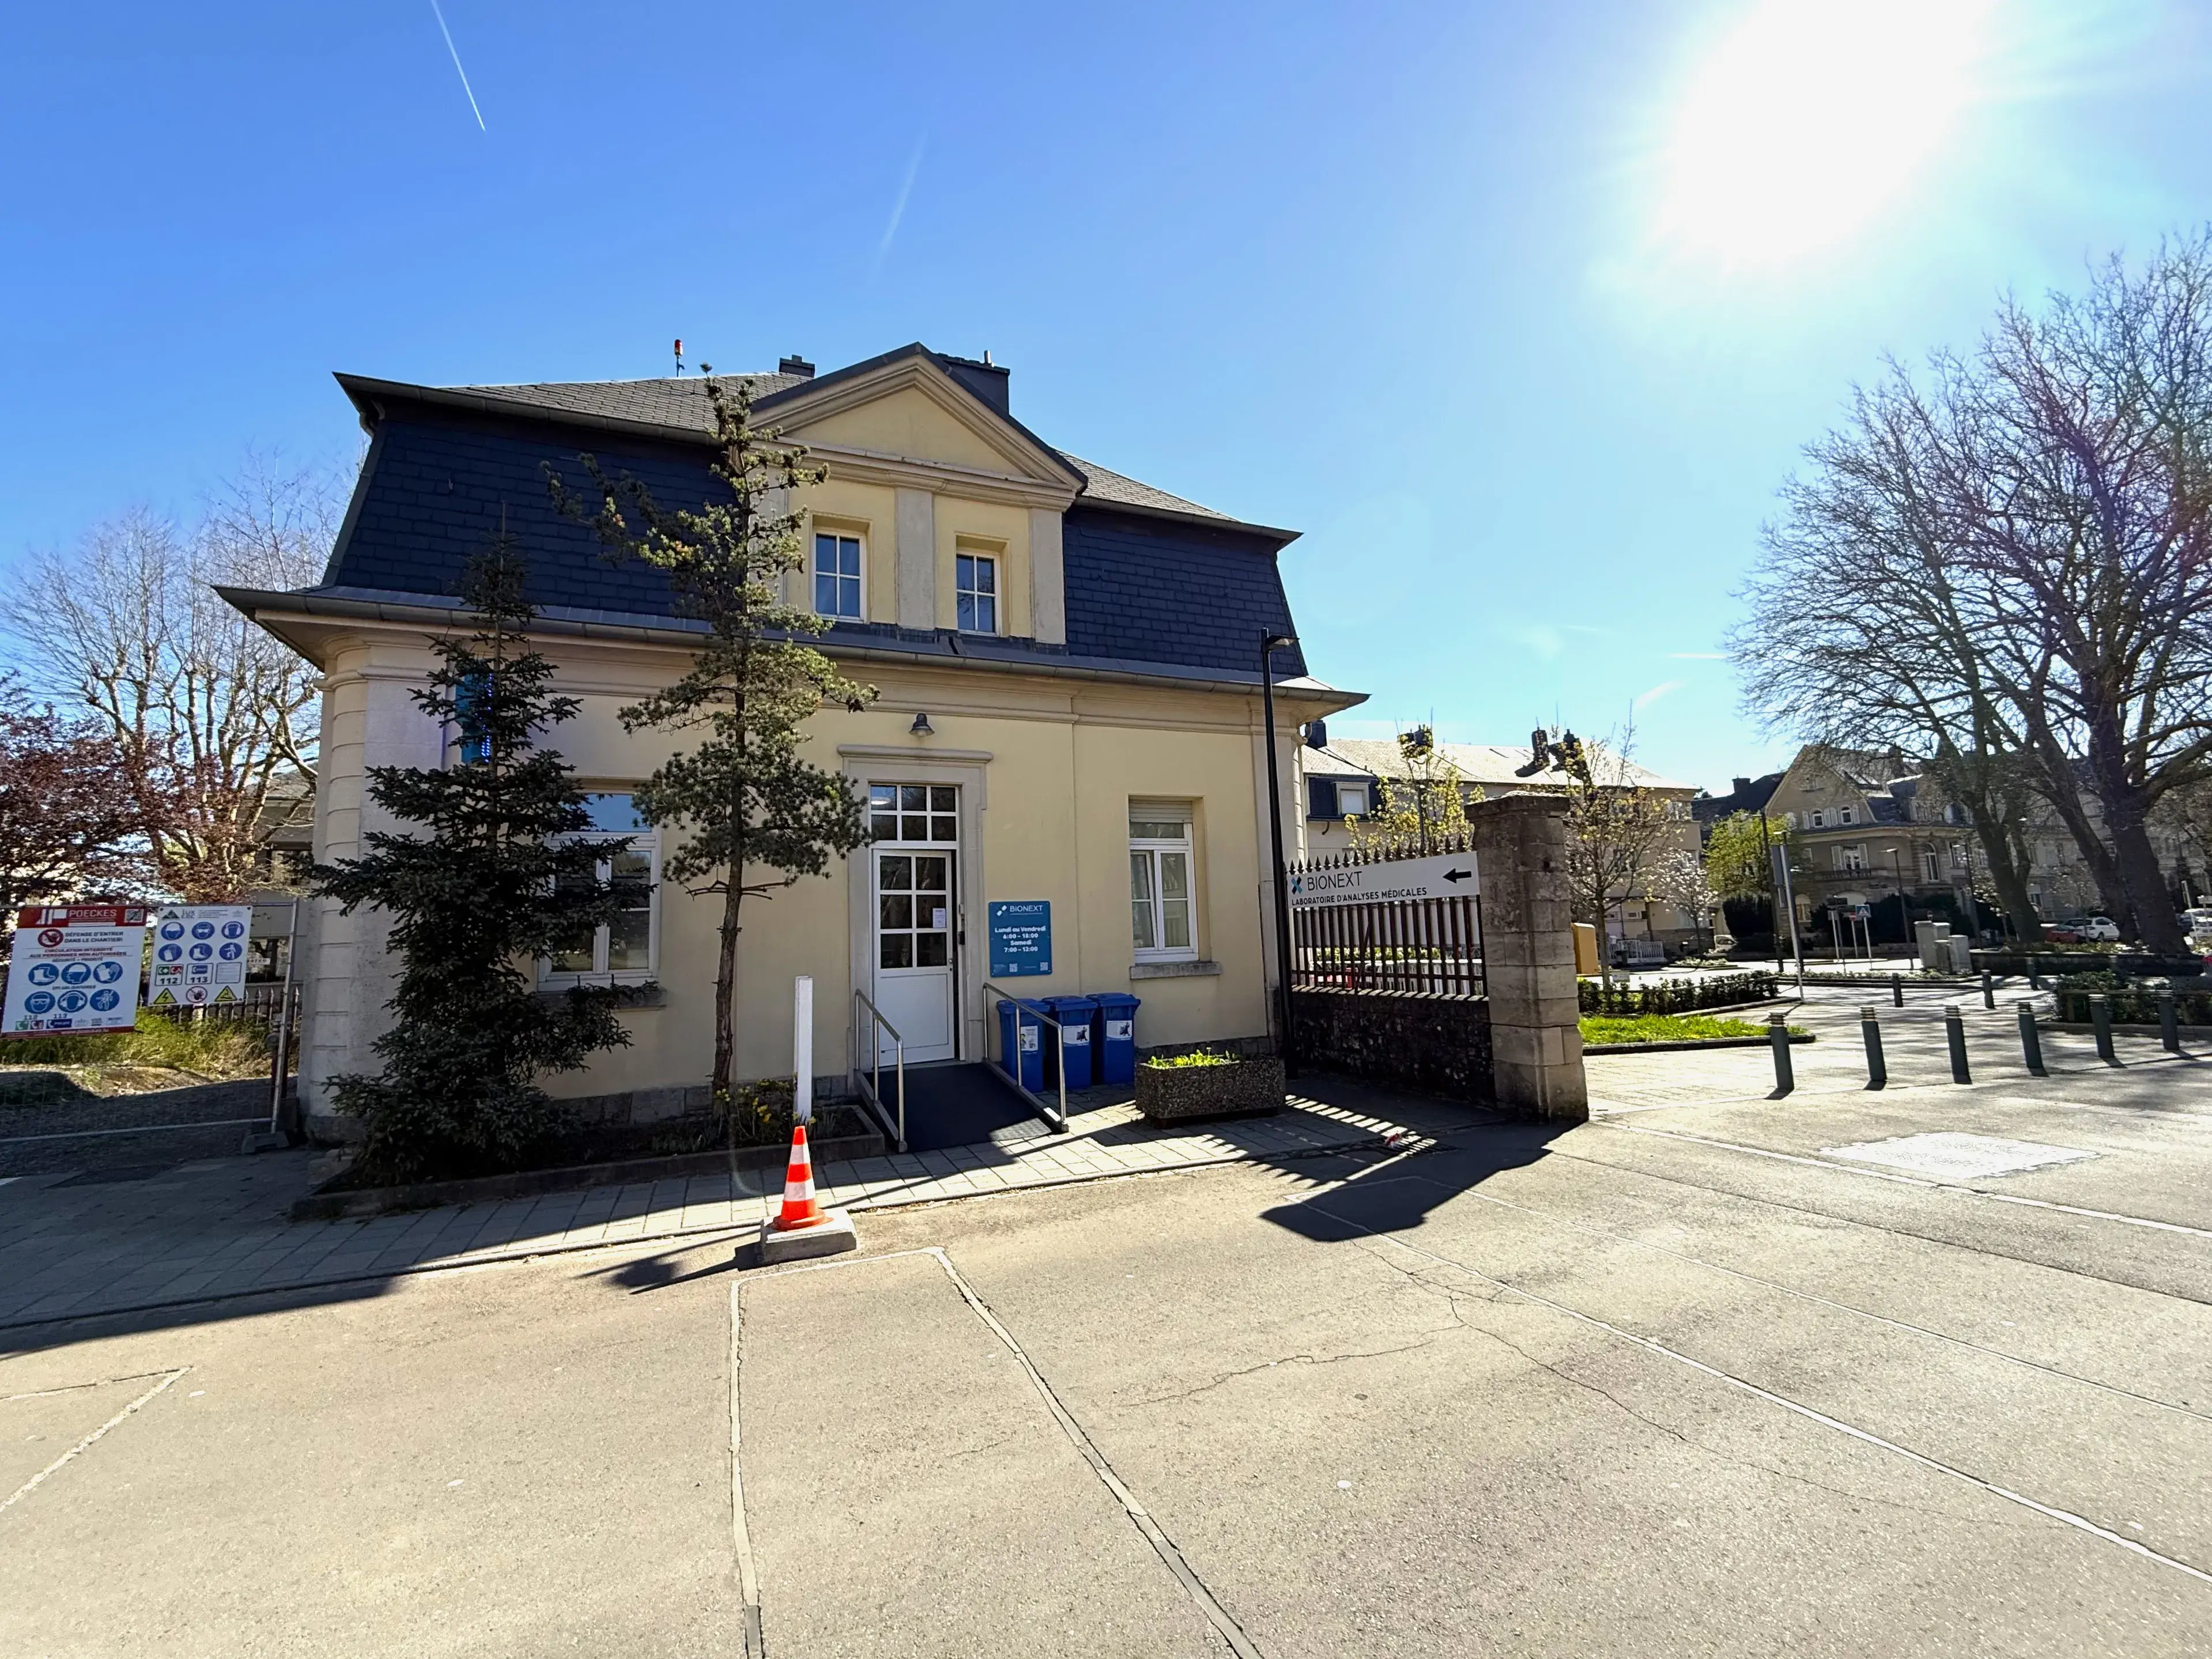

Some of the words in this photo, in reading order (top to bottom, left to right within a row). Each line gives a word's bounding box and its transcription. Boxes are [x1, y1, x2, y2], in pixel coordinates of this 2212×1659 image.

[1307, 871, 1362, 891] BIONEXT
[1292, 895, 1335, 906] LABORATOIRE
[1337, 892, 1379, 902] D'ANALYSES
[1381, 887, 1427, 899] MÉDICALES
[69, 909, 117, 917] POECKES
